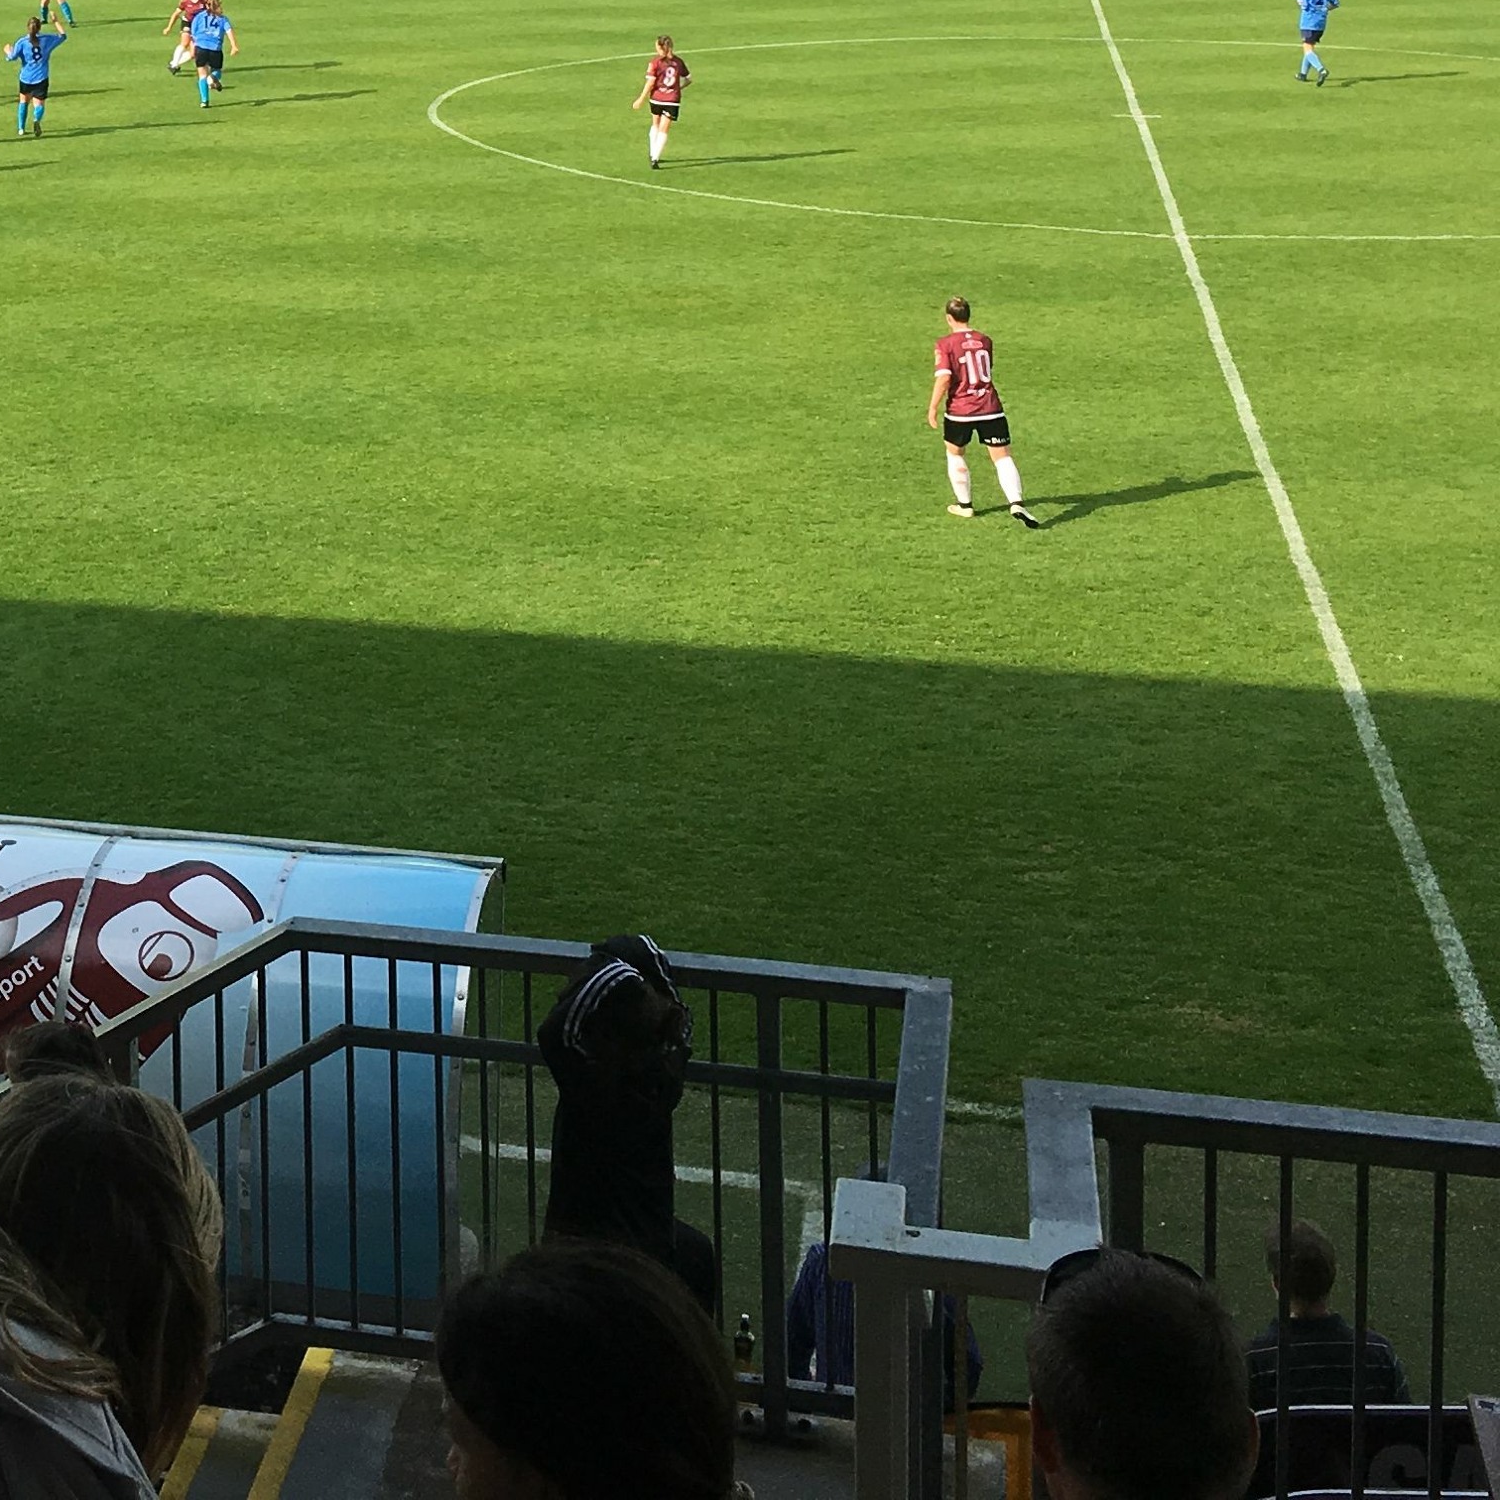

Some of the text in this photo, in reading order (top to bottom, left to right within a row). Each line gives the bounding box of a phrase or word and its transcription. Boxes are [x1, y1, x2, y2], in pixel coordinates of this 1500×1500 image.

[203, 15, 220, 30] 14
[663, 66, 676, 87] 8
[958, 349, 992, 386] 10
